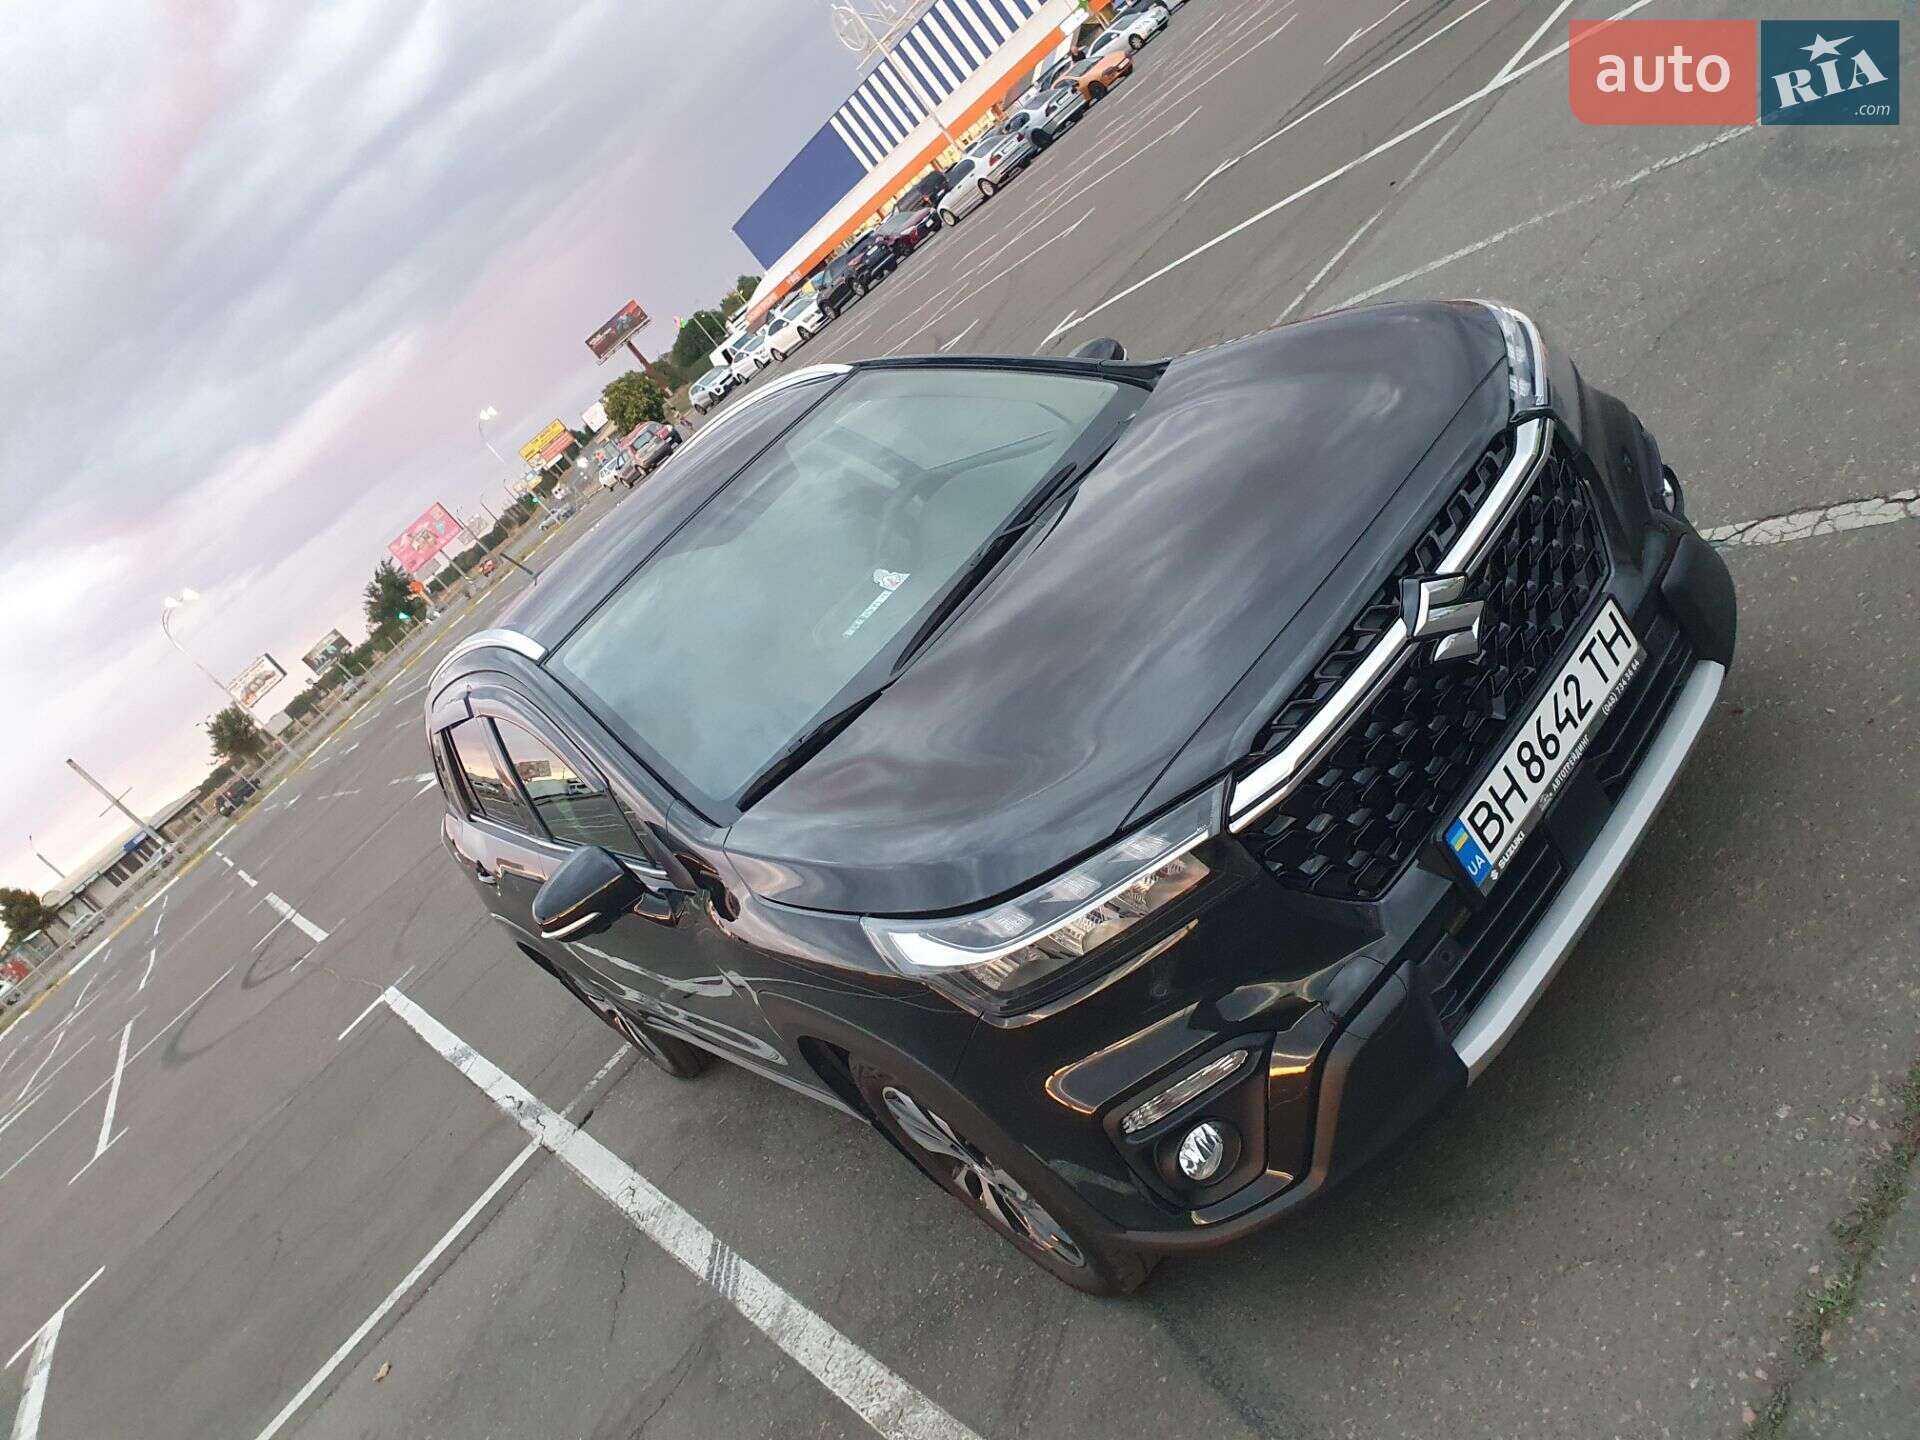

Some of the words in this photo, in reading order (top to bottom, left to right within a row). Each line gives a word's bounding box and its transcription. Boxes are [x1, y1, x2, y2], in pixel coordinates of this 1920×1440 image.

[1467, 764, 1529, 854] BH
[1516, 673, 1593, 784] 8642
[1578, 611, 1632, 684] TH
[1552, 734, 1591, 792] АВТОТРЕЙДИНГ
[1467, 855, 1486, 876] UA
[1498, 830, 1525, 870] SUZUKI
